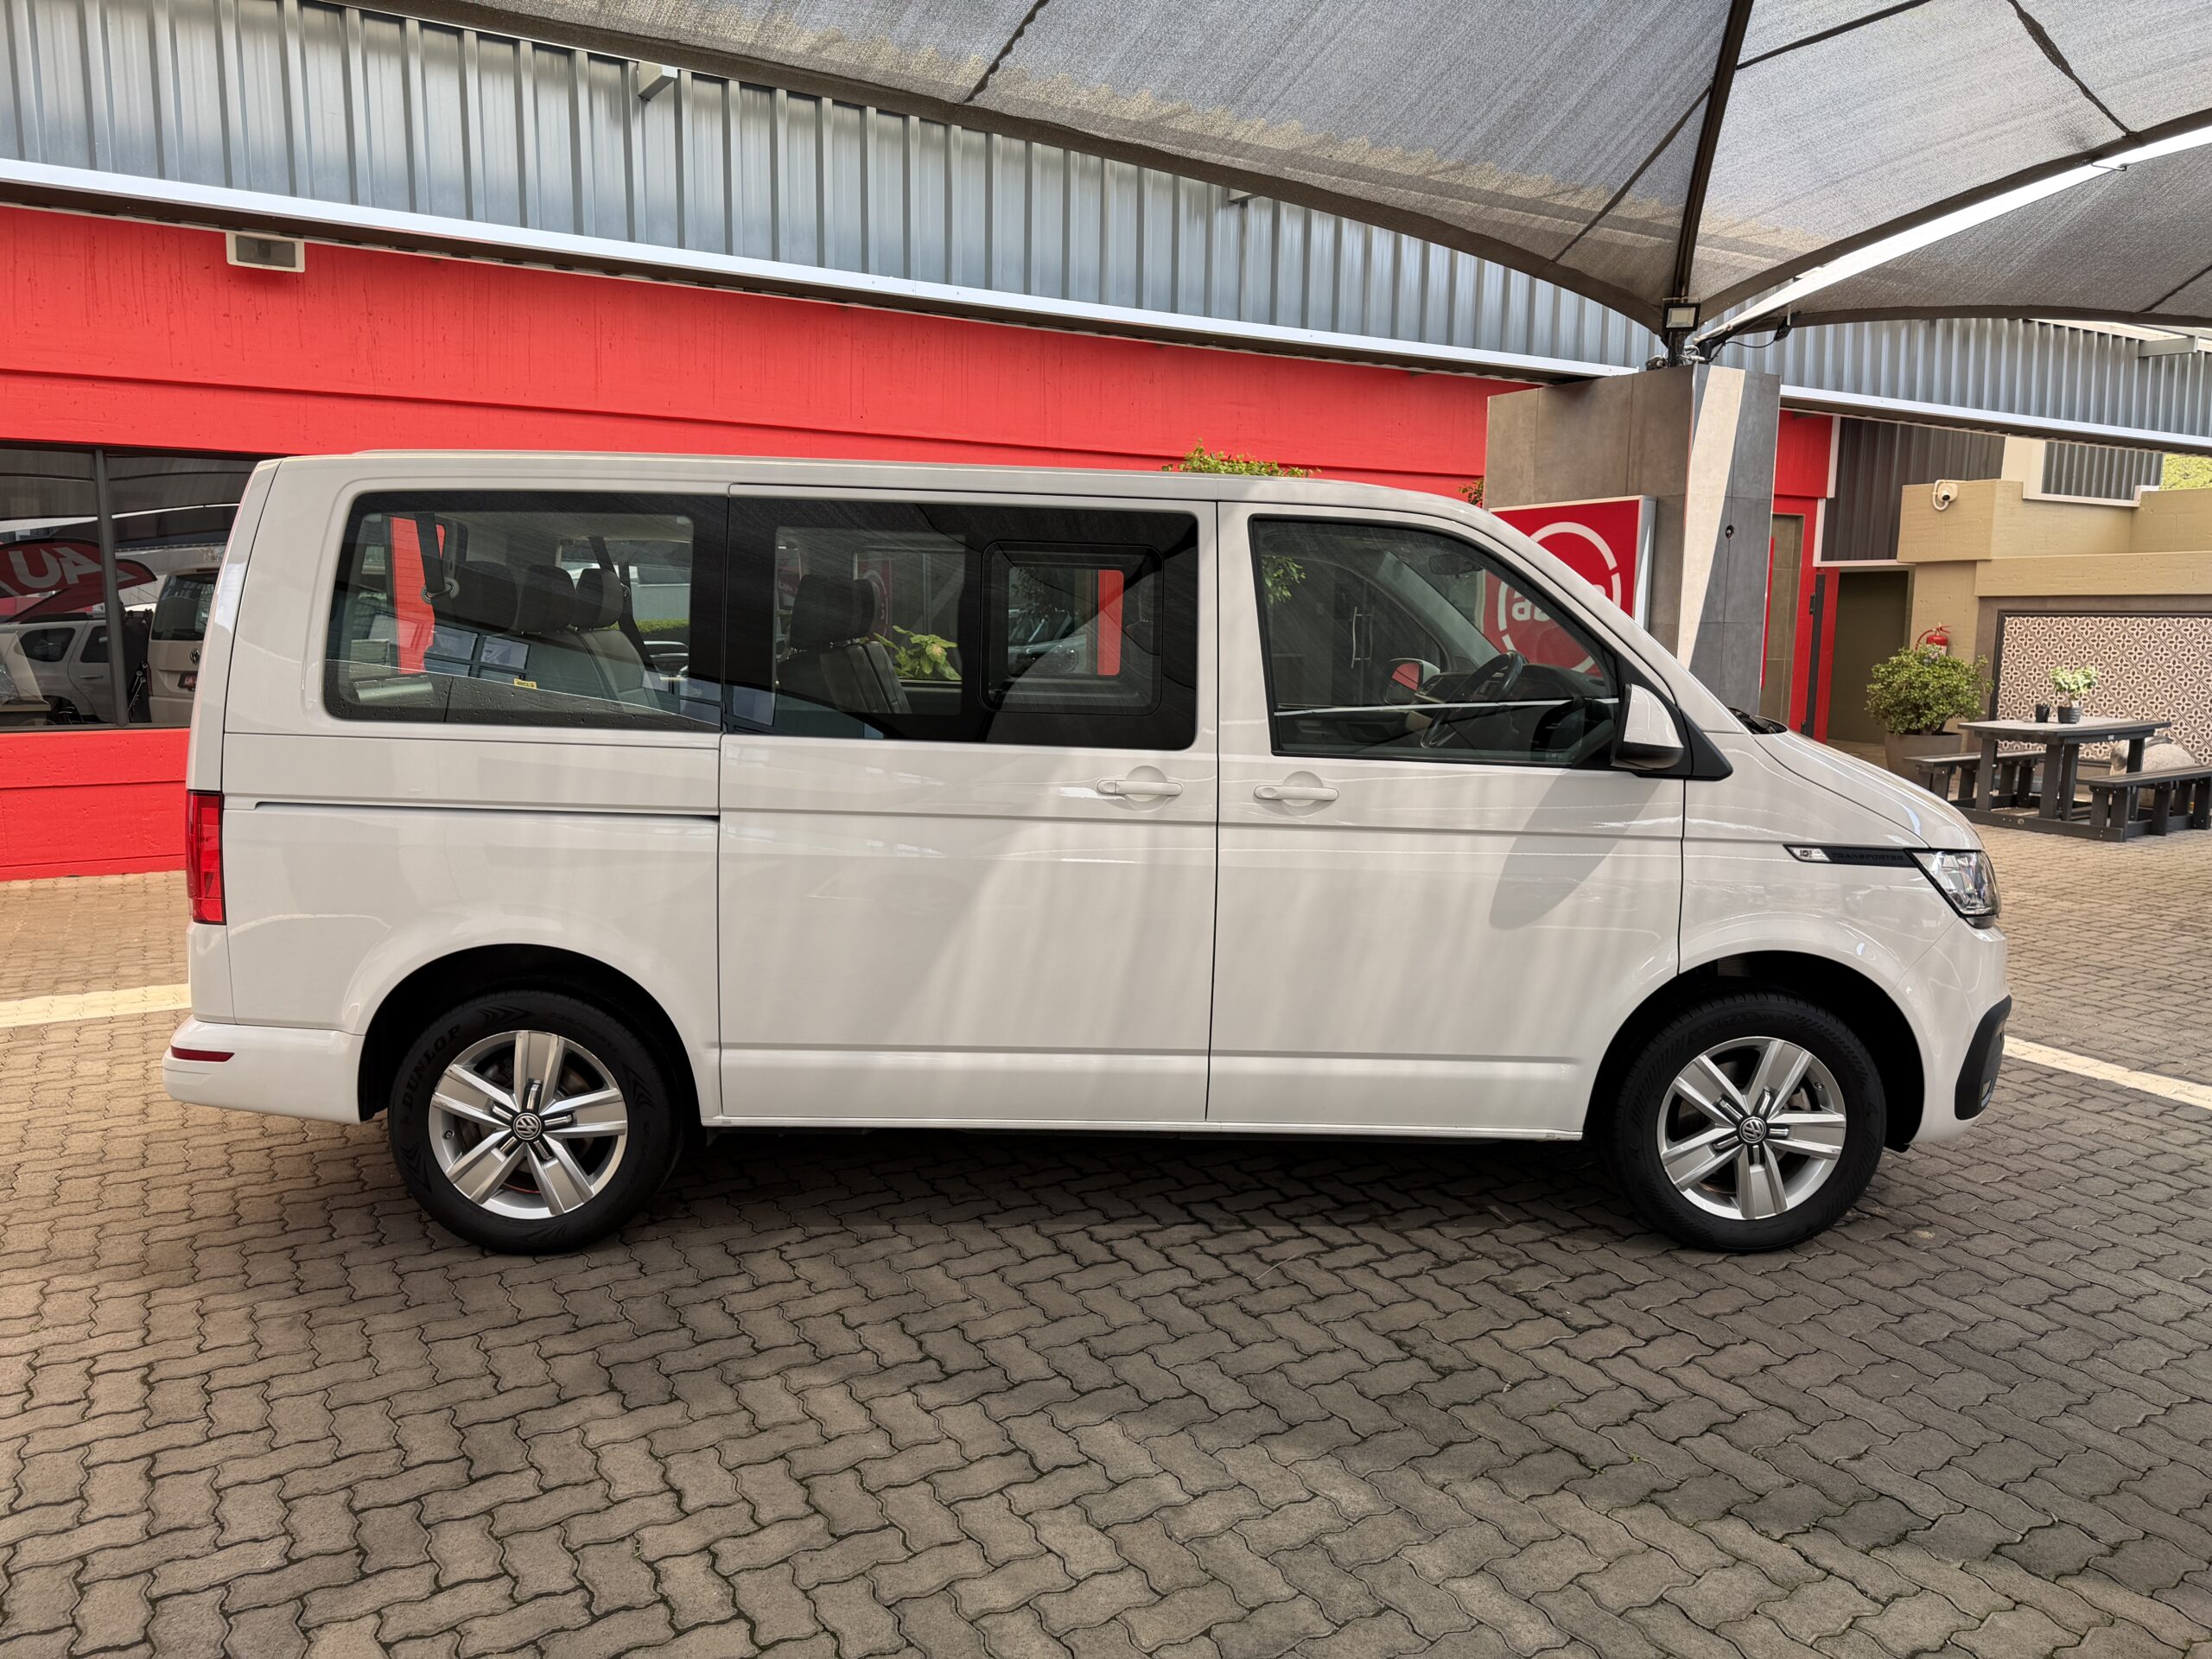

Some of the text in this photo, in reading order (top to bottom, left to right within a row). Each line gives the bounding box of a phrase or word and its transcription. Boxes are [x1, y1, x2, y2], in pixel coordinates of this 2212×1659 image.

[1831, 852, 1904, 861] TRANSPORTER
[402, 1024, 461, 1112] DUNLOP
[515, 1114, 540, 1138] VW
[1742, 1118, 1765, 1141] VW
